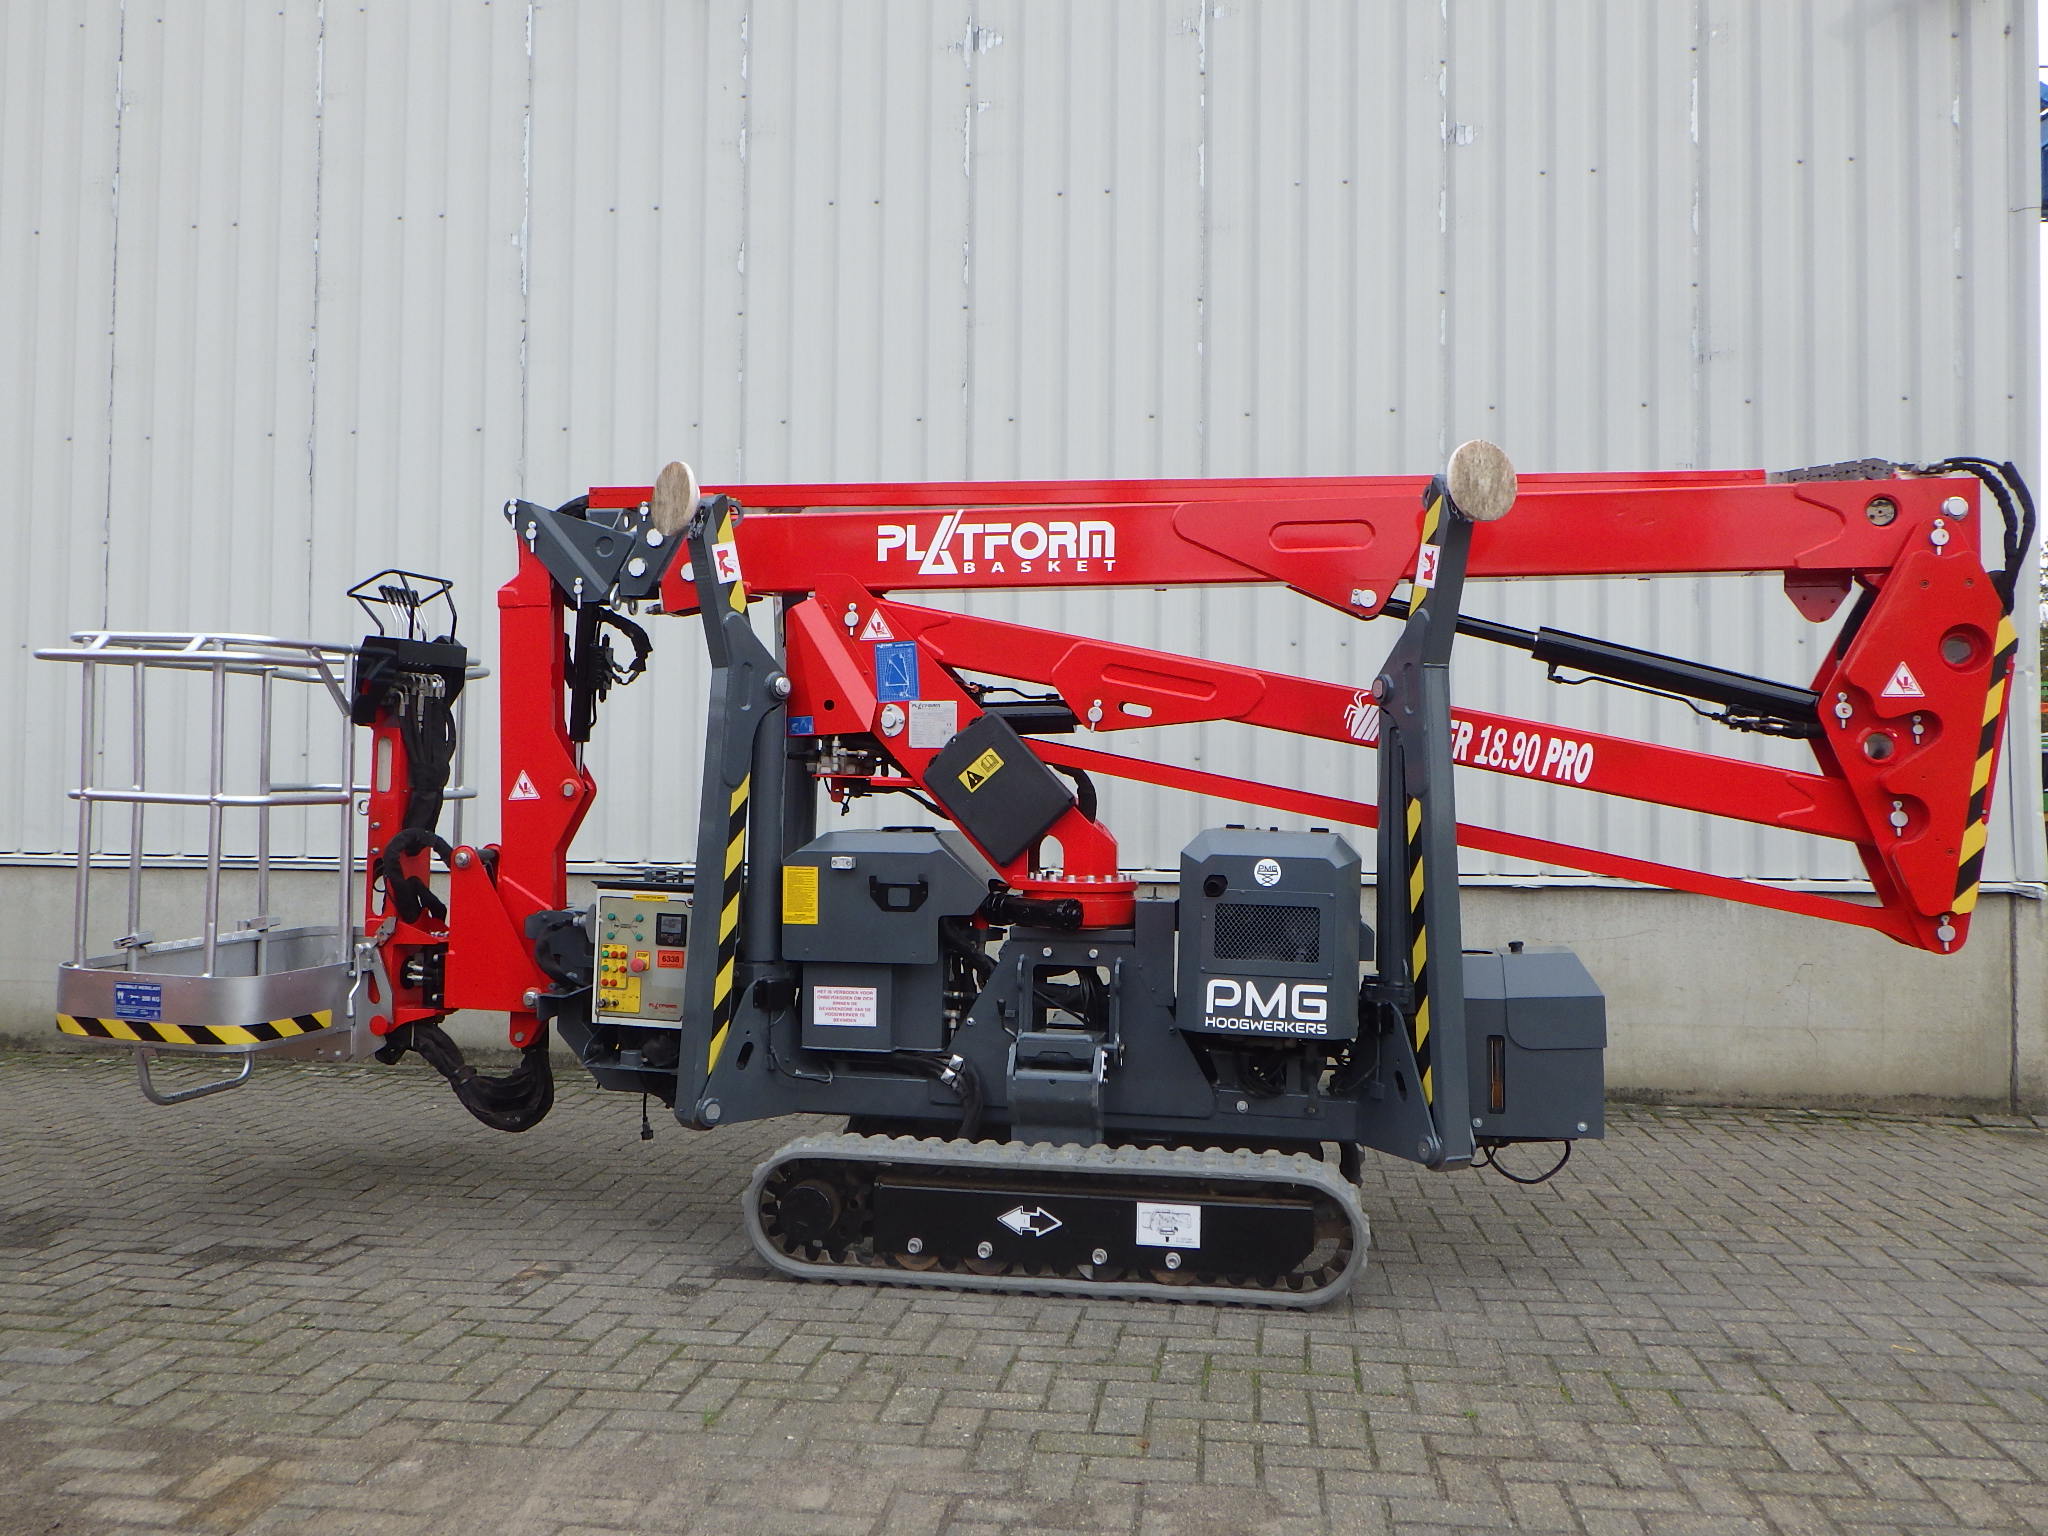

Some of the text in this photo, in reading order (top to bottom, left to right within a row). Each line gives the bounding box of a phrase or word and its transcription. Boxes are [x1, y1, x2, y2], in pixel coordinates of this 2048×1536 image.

[877, 509, 1115, 574] PLATFORM
[963, 560, 1116, 574] BASKET
[1474, 725, 1541, 774] 18.90
[1542, 738, 1594, 784] PRO
[662, 955, 679, 964] 6338
[1206, 979, 1328, 1021] PMG
[1205, 1016, 1328, 1035] HOOGWERKERS
